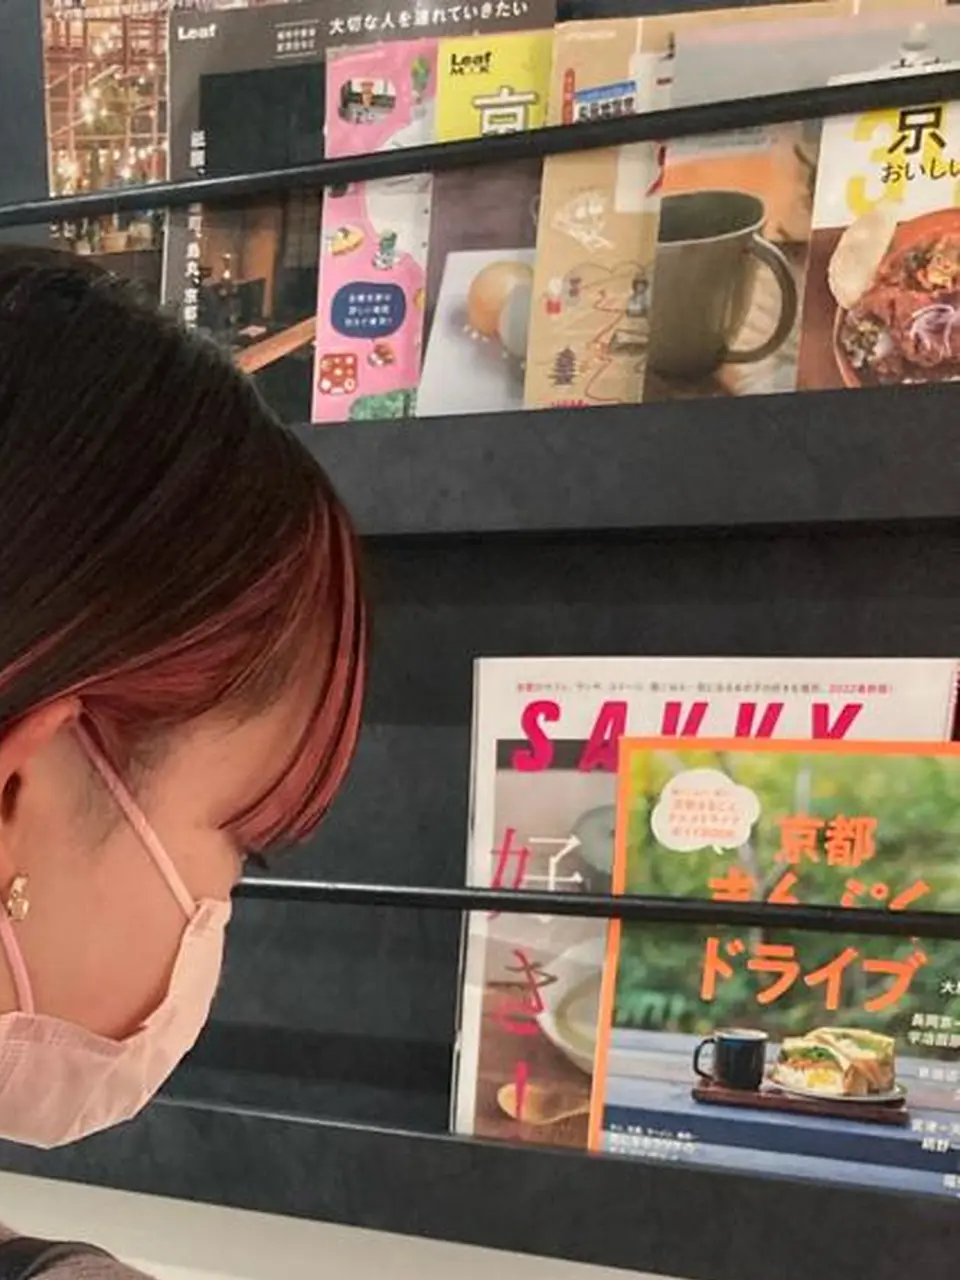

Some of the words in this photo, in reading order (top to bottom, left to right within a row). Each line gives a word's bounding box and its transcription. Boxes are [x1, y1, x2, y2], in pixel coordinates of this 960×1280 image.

[177, 23, 217, 41] Leaf
[450, 52, 492, 67] Leaf
[774, 815, 877, 867] 京都
[701, 936, 928, 1012] ドライブ
